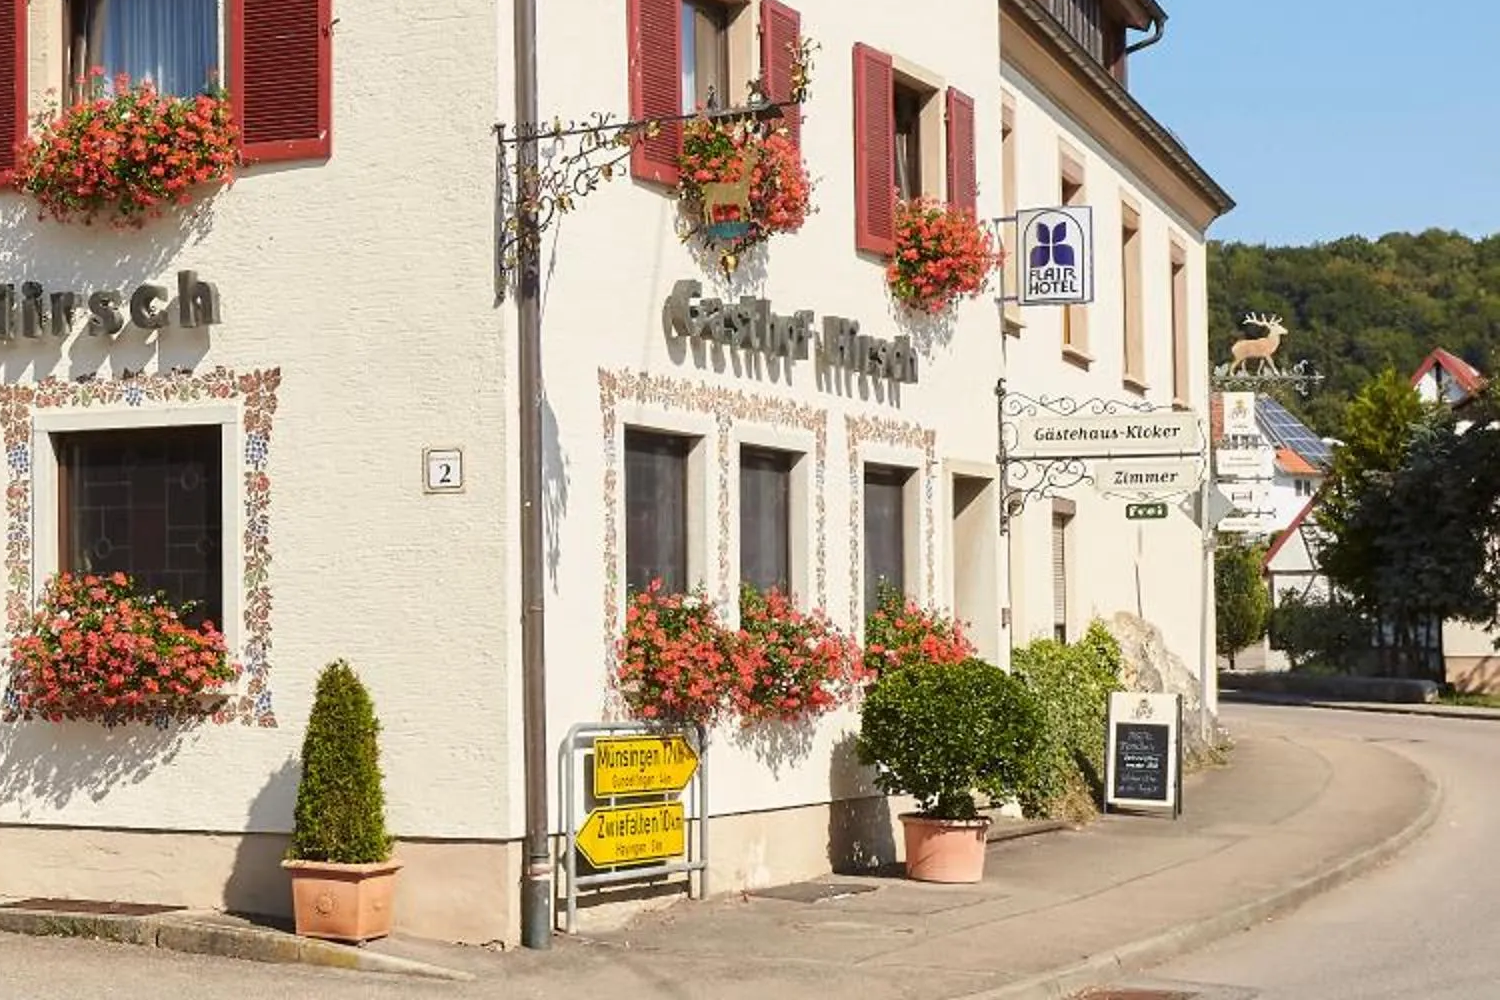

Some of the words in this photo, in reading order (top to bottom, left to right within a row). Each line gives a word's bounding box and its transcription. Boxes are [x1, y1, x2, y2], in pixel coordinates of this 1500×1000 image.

[1029, 267, 1077, 284] FLAIR
[1028, 280, 1078, 295] HOTEL
[439, 463, 452, 483] 2
[1114, 471, 1179, 485] Zimmer
[597, 743, 660, 773] Münsingen
[597, 811, 659, 839] Zwiefalten
